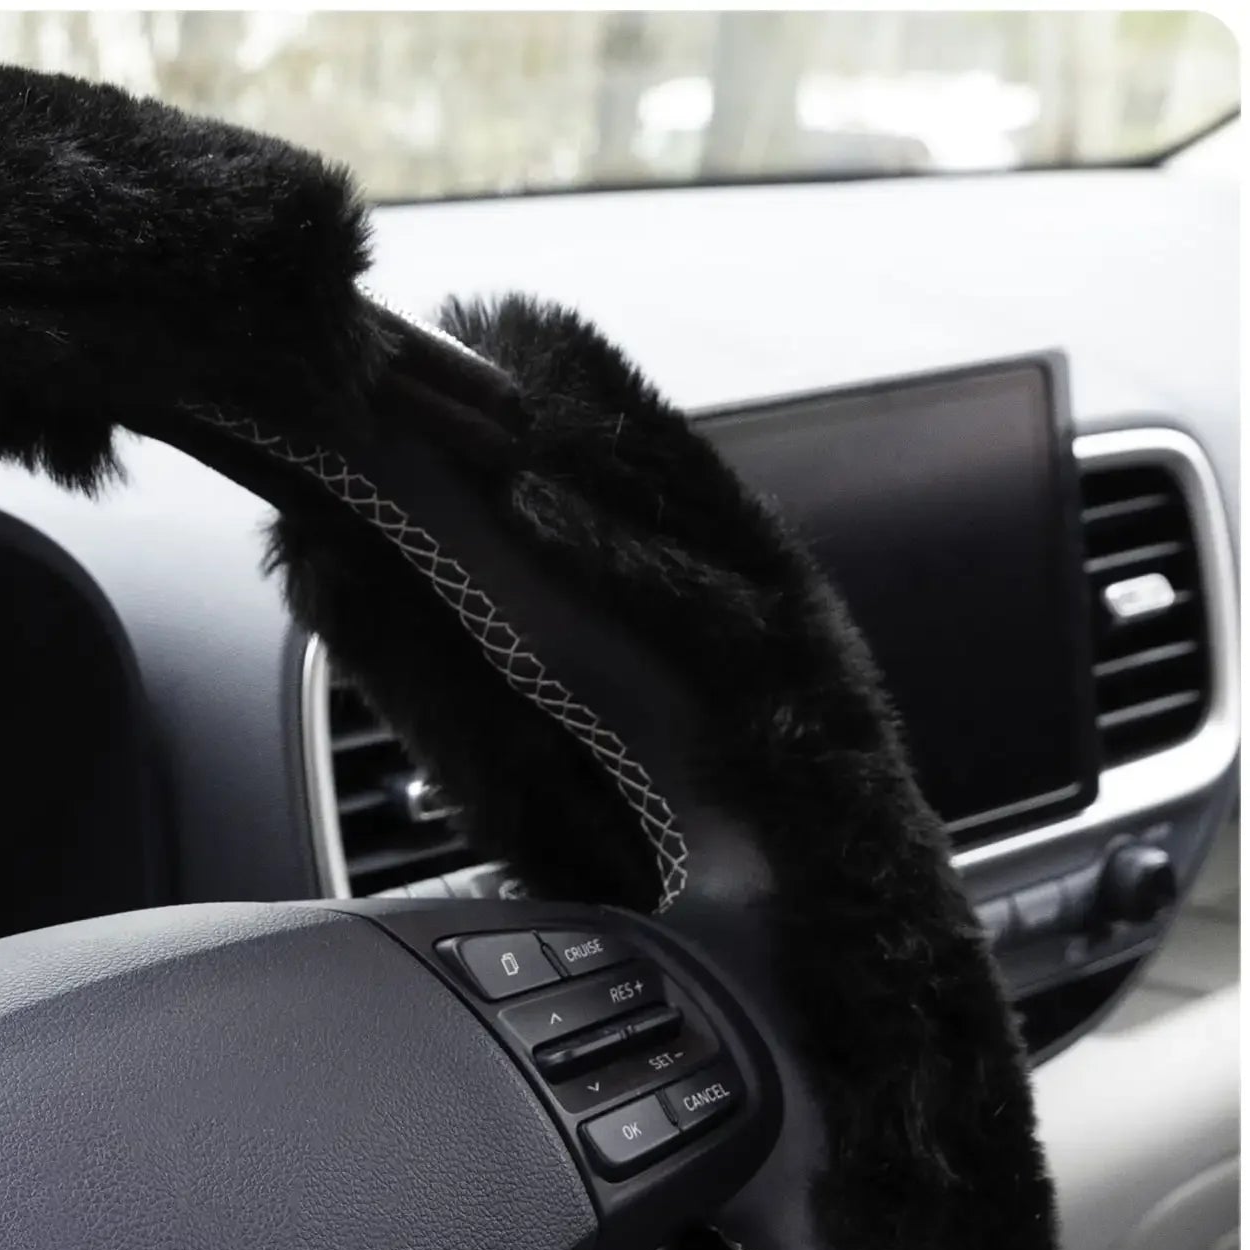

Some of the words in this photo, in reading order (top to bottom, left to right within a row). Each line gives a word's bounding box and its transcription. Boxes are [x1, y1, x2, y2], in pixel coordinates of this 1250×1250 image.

[564, 938, 604, 962] CRUISE
[682, 1083, 730, 1111] CANCEL
[622, 1122, 642, 1140] OK
